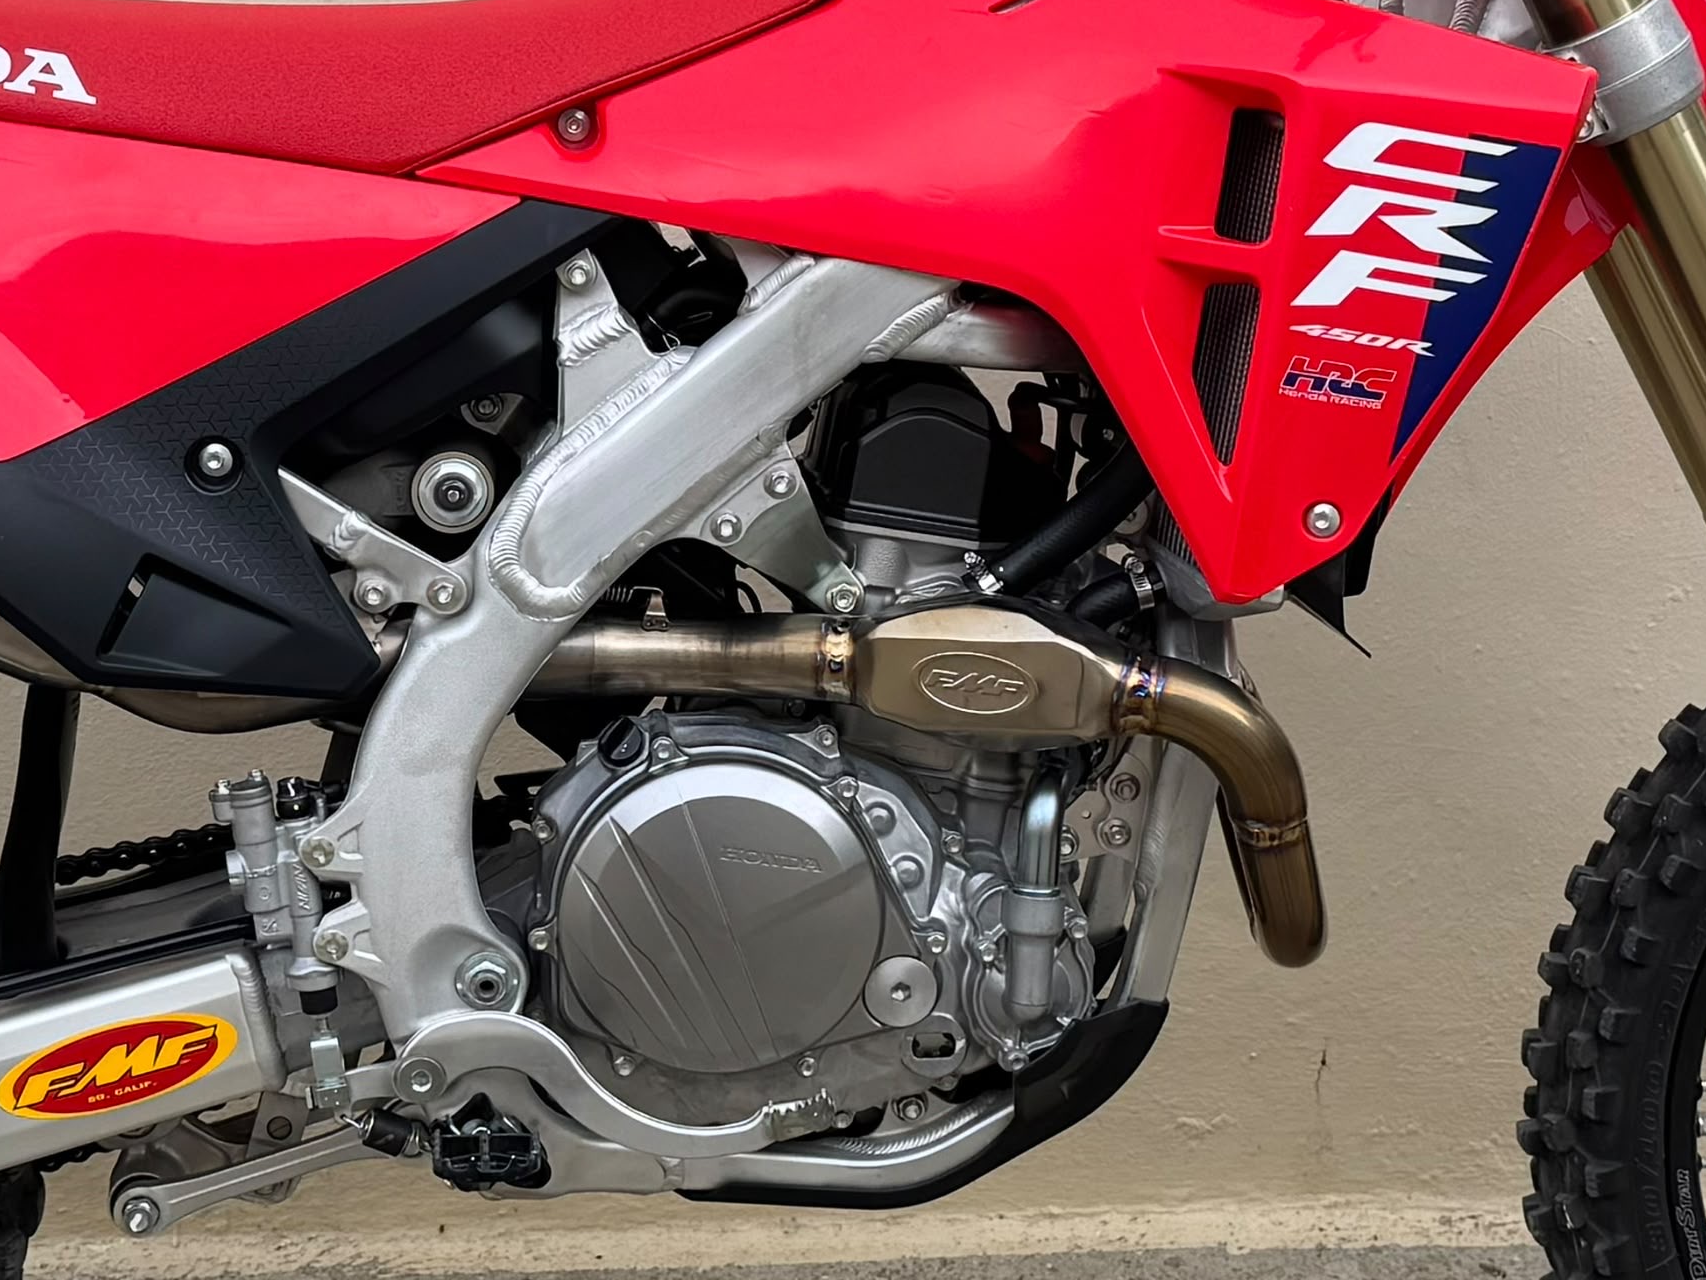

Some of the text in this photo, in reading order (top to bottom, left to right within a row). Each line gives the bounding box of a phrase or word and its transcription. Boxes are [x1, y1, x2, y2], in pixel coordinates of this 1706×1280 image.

[1290, 122, 1514, 307] CRF
[1289, 324, 1436, 357] 450R
[1280, 355, 1397, 402] HRC
[1329, 396, 1382, 410] RACING
[13, 1024, 218, 1110] FMF
